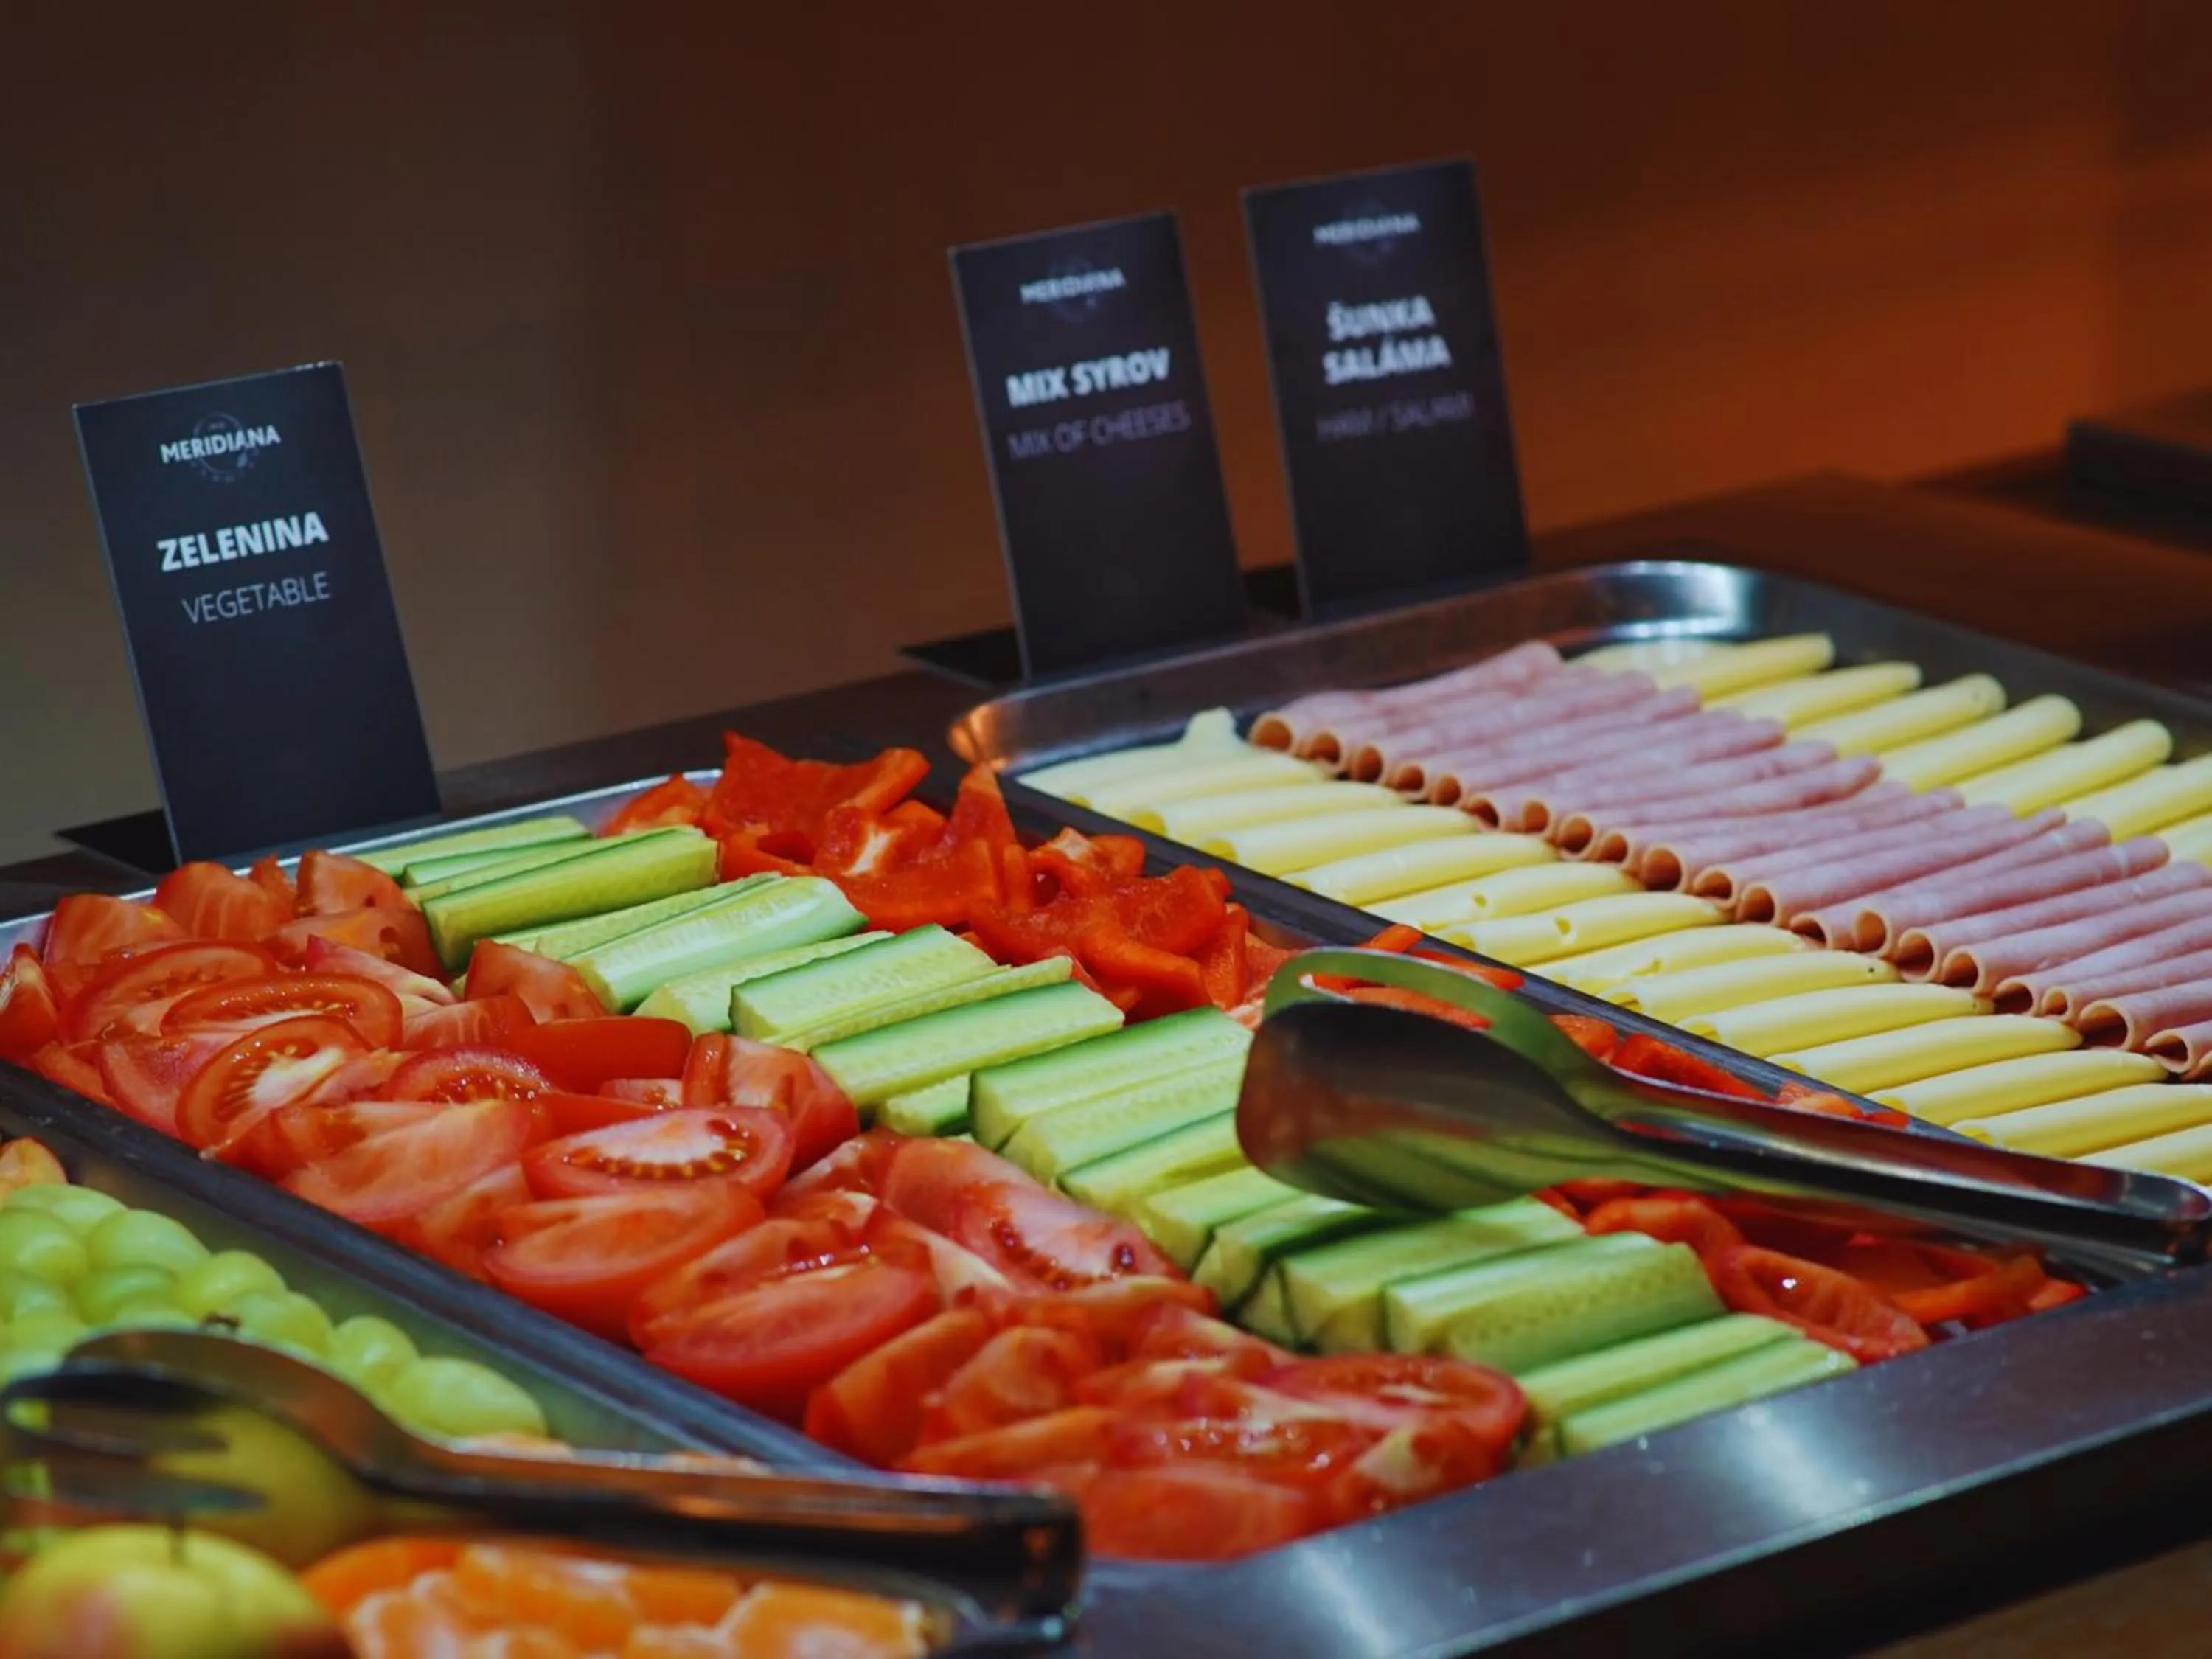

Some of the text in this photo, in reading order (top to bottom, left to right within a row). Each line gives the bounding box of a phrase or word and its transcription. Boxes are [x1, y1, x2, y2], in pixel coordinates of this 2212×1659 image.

[1020, 266, 1127, 304] MERIDIANA
[1006, 346, 1169, 408] MIX SYROV
[160, 425, 281, 464] MERIDIANA
[1007, 431, 1051, 460] MIX
[1054, 419, 1088, 453] OF
[157, 512, 329, 571] ZELENINA
[181, 572, 330, 624] VEGETABLE
